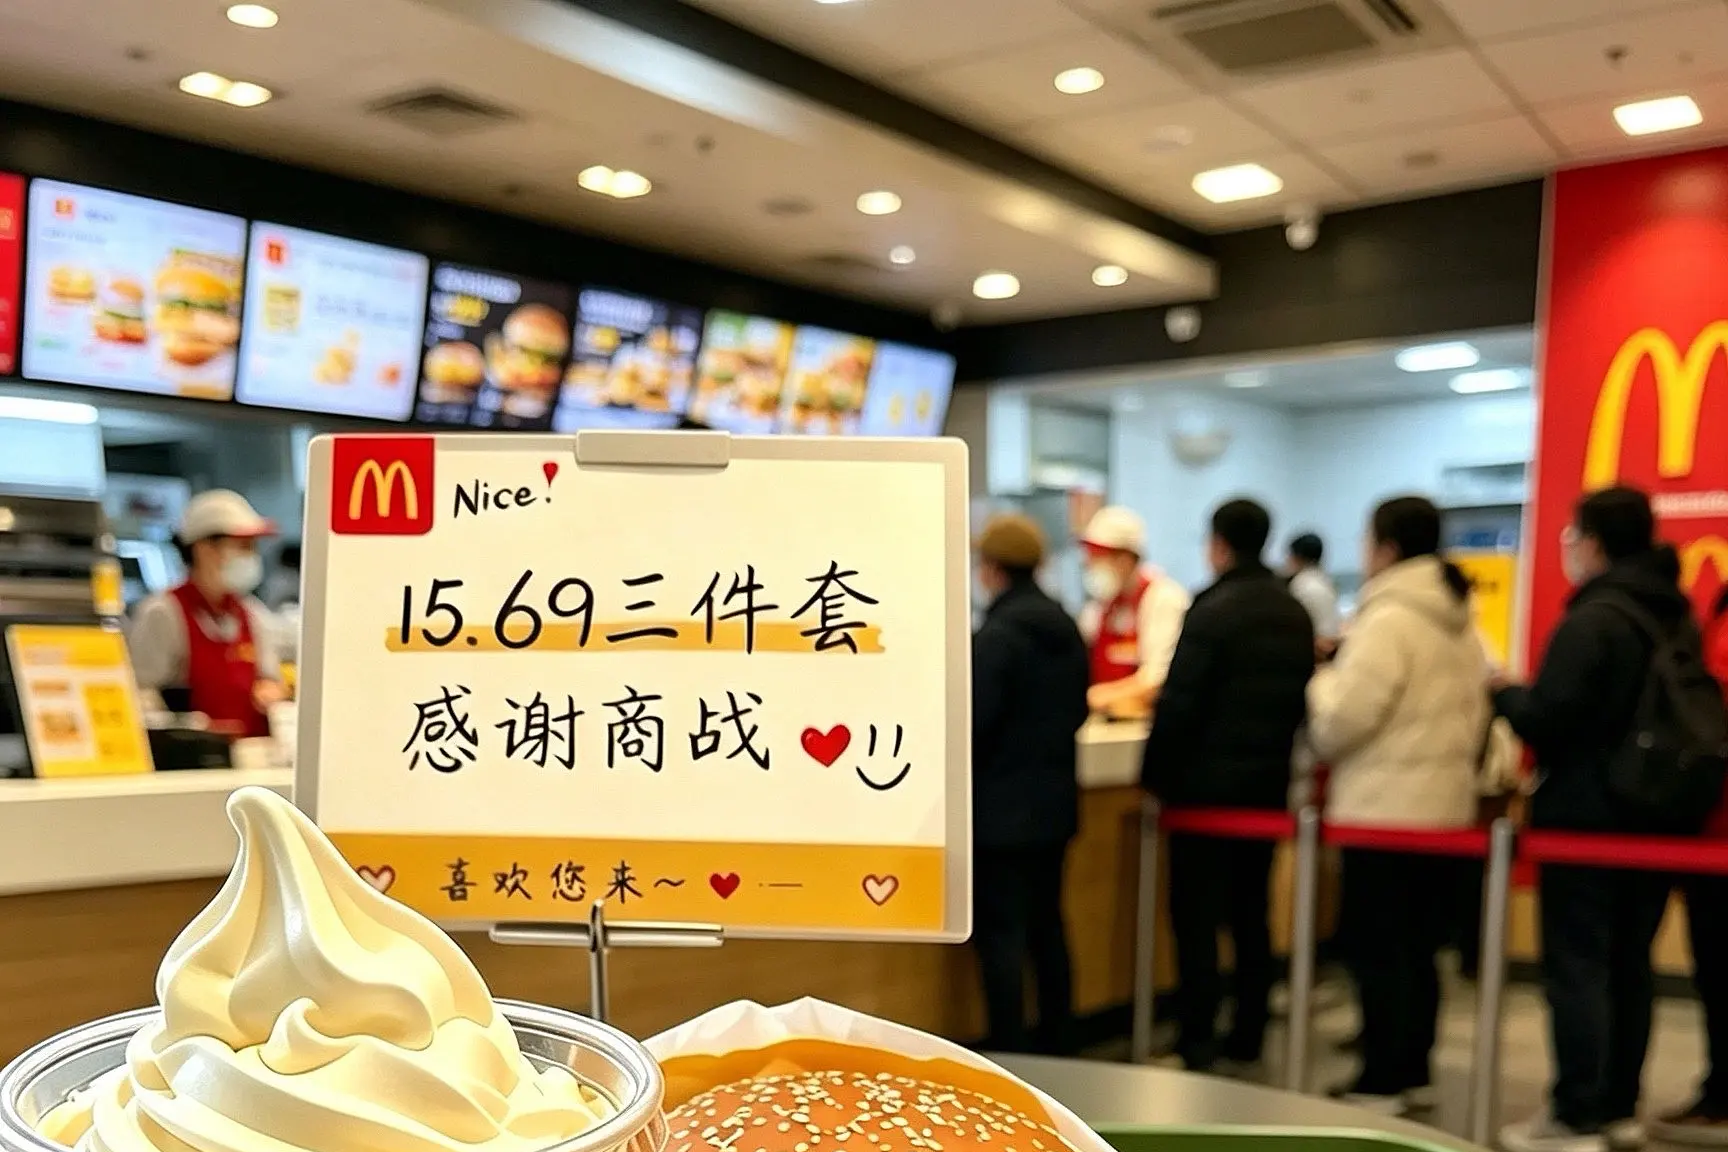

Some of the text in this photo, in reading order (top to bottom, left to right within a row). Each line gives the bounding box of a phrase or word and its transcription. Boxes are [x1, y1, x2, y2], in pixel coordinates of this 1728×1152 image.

[400, 560, 879, 655] 15.69三件套
[402, 684, 770, 774] 感谢商战
